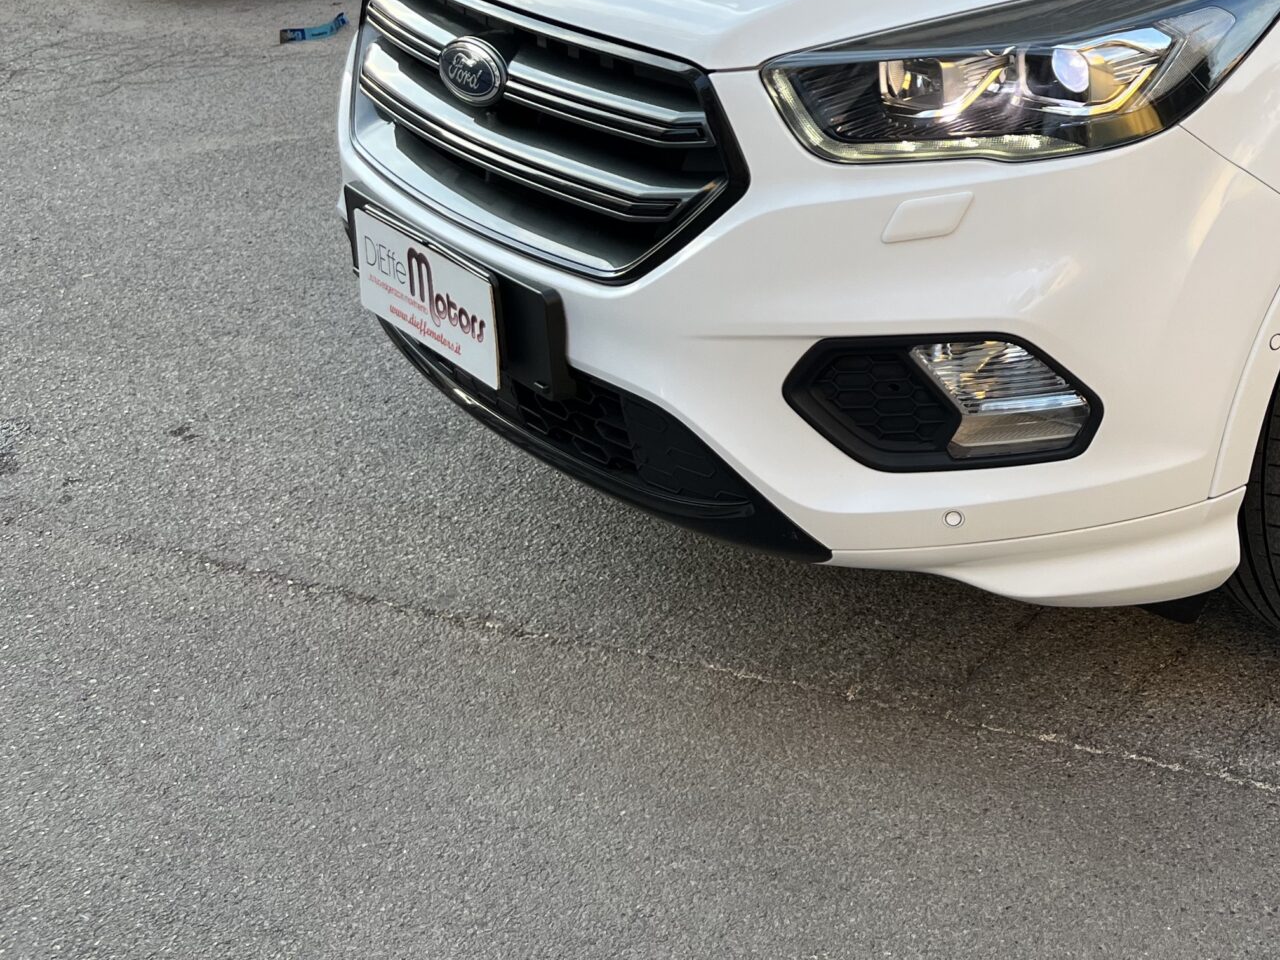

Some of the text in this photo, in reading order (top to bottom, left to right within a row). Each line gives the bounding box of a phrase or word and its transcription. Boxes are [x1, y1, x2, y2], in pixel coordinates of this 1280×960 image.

[448, 52, 483, 90] Ford
[364, 235, 407, 285] DiEffe
[407, 247, 486, 343] Motors
